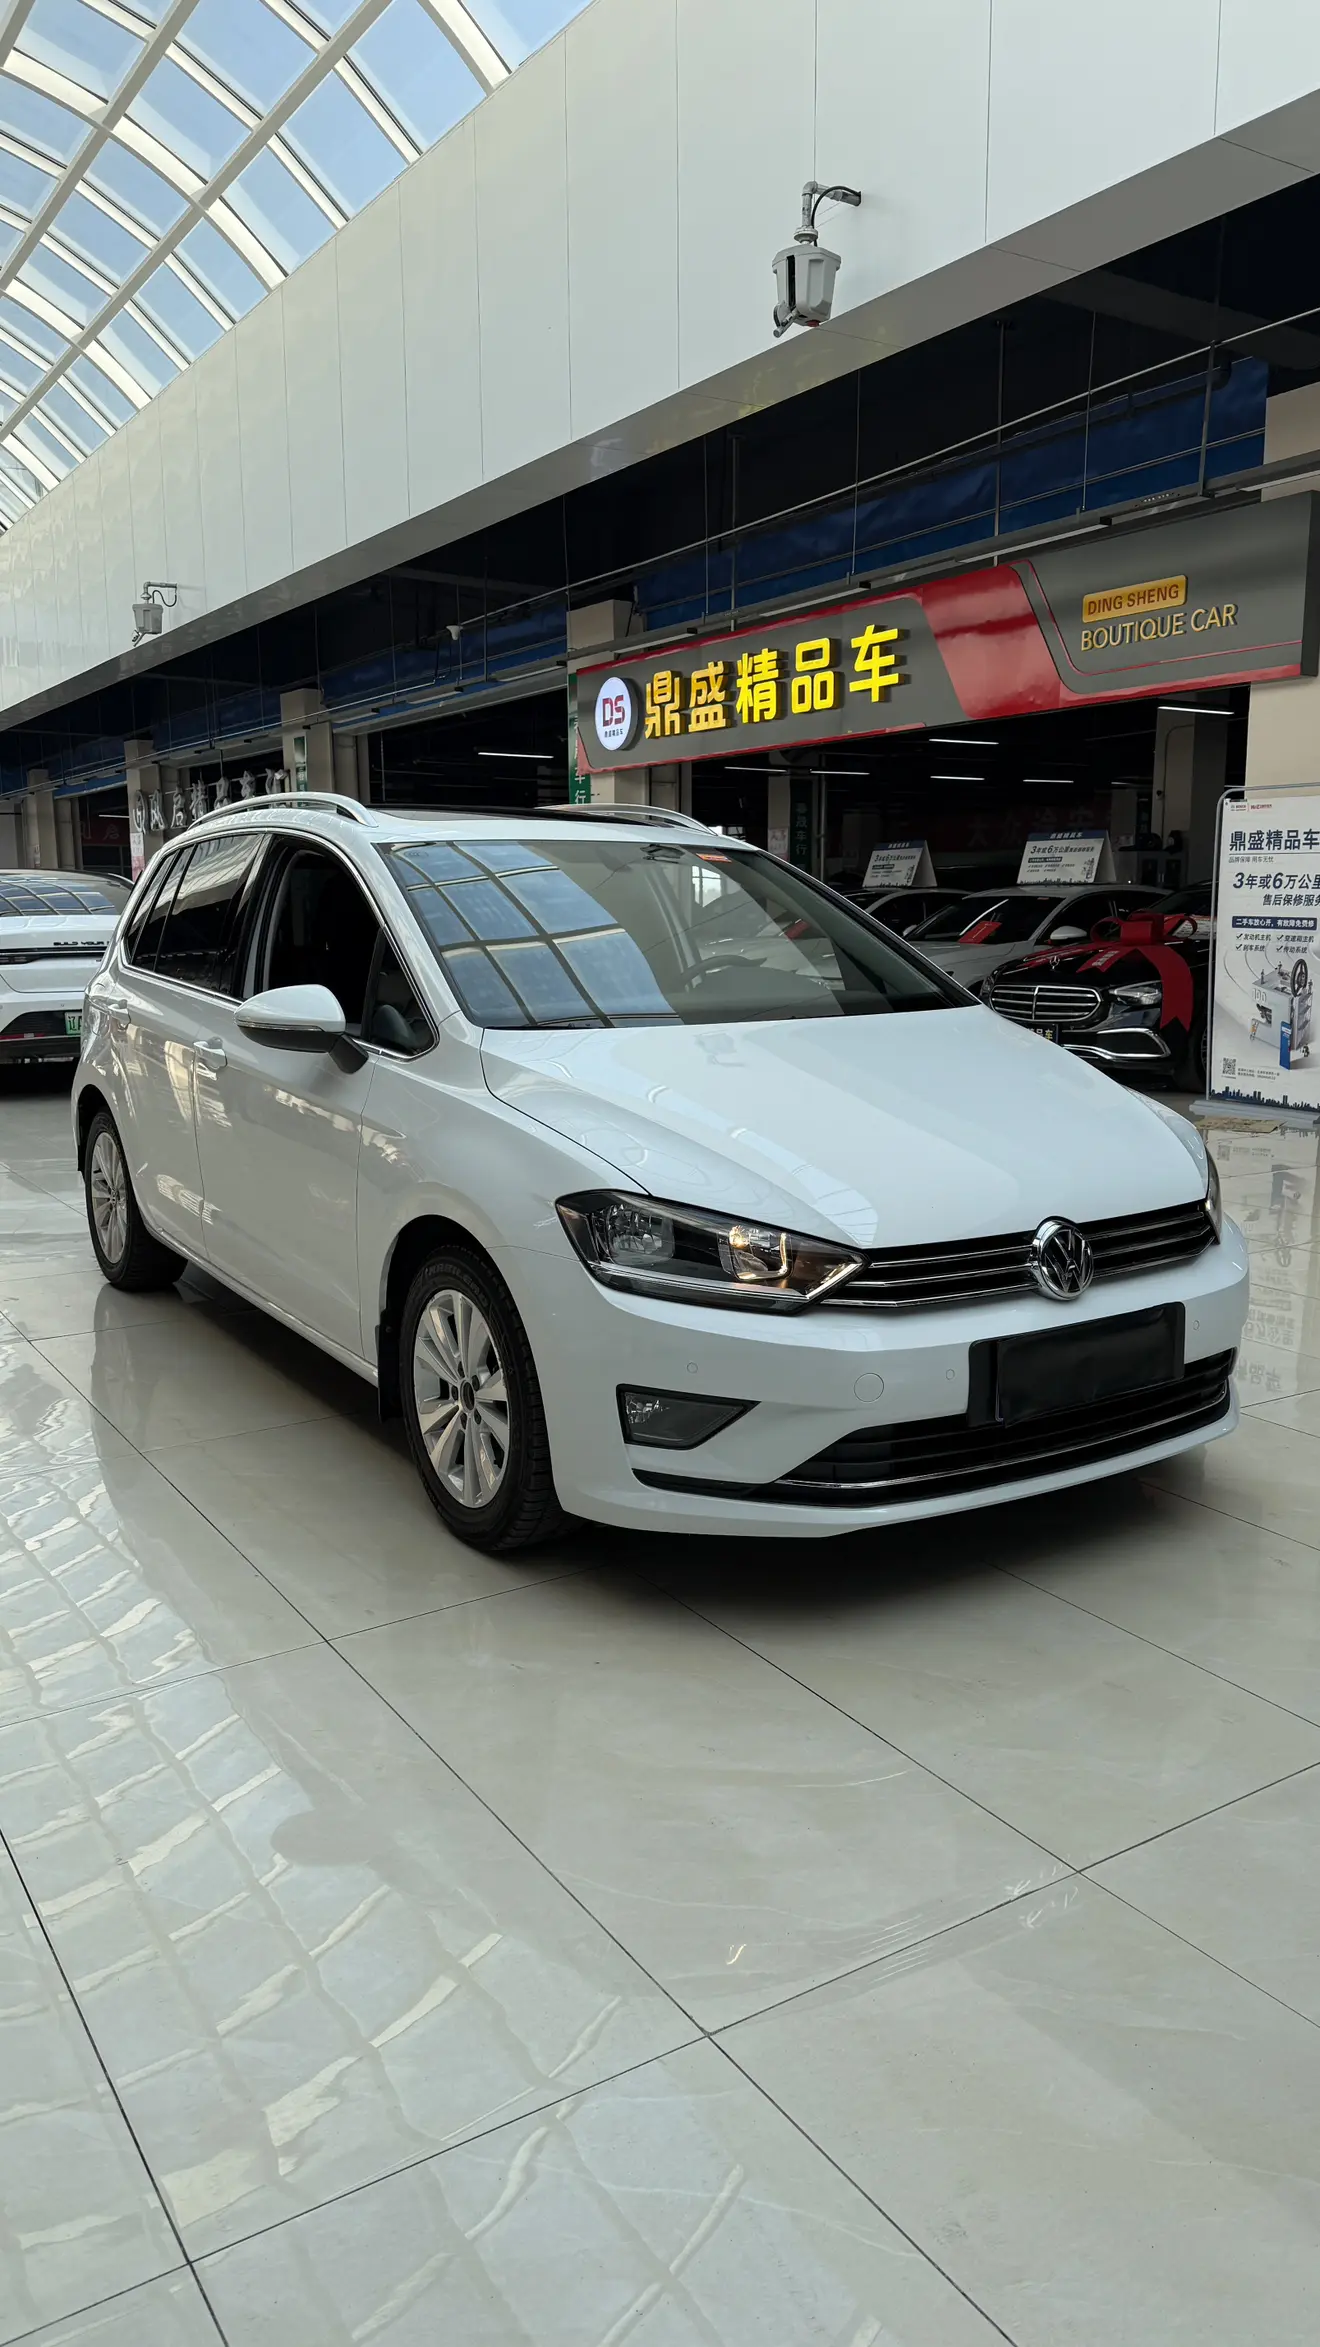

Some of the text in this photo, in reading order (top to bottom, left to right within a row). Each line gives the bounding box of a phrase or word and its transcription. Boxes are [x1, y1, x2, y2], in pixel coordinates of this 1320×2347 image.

[1087, 584, 1180, 616] DING SHENG
[1081, 603, 1237, 651] BOUTIQUE CAR
[644, 624, 899, 739] 鼎盛精品车
[602, 694, 626, 728] DS
[1229, 829, 1320, 851] 鼎盛精品车
[1232, 872, 1320, 890] 3年或6万公里
